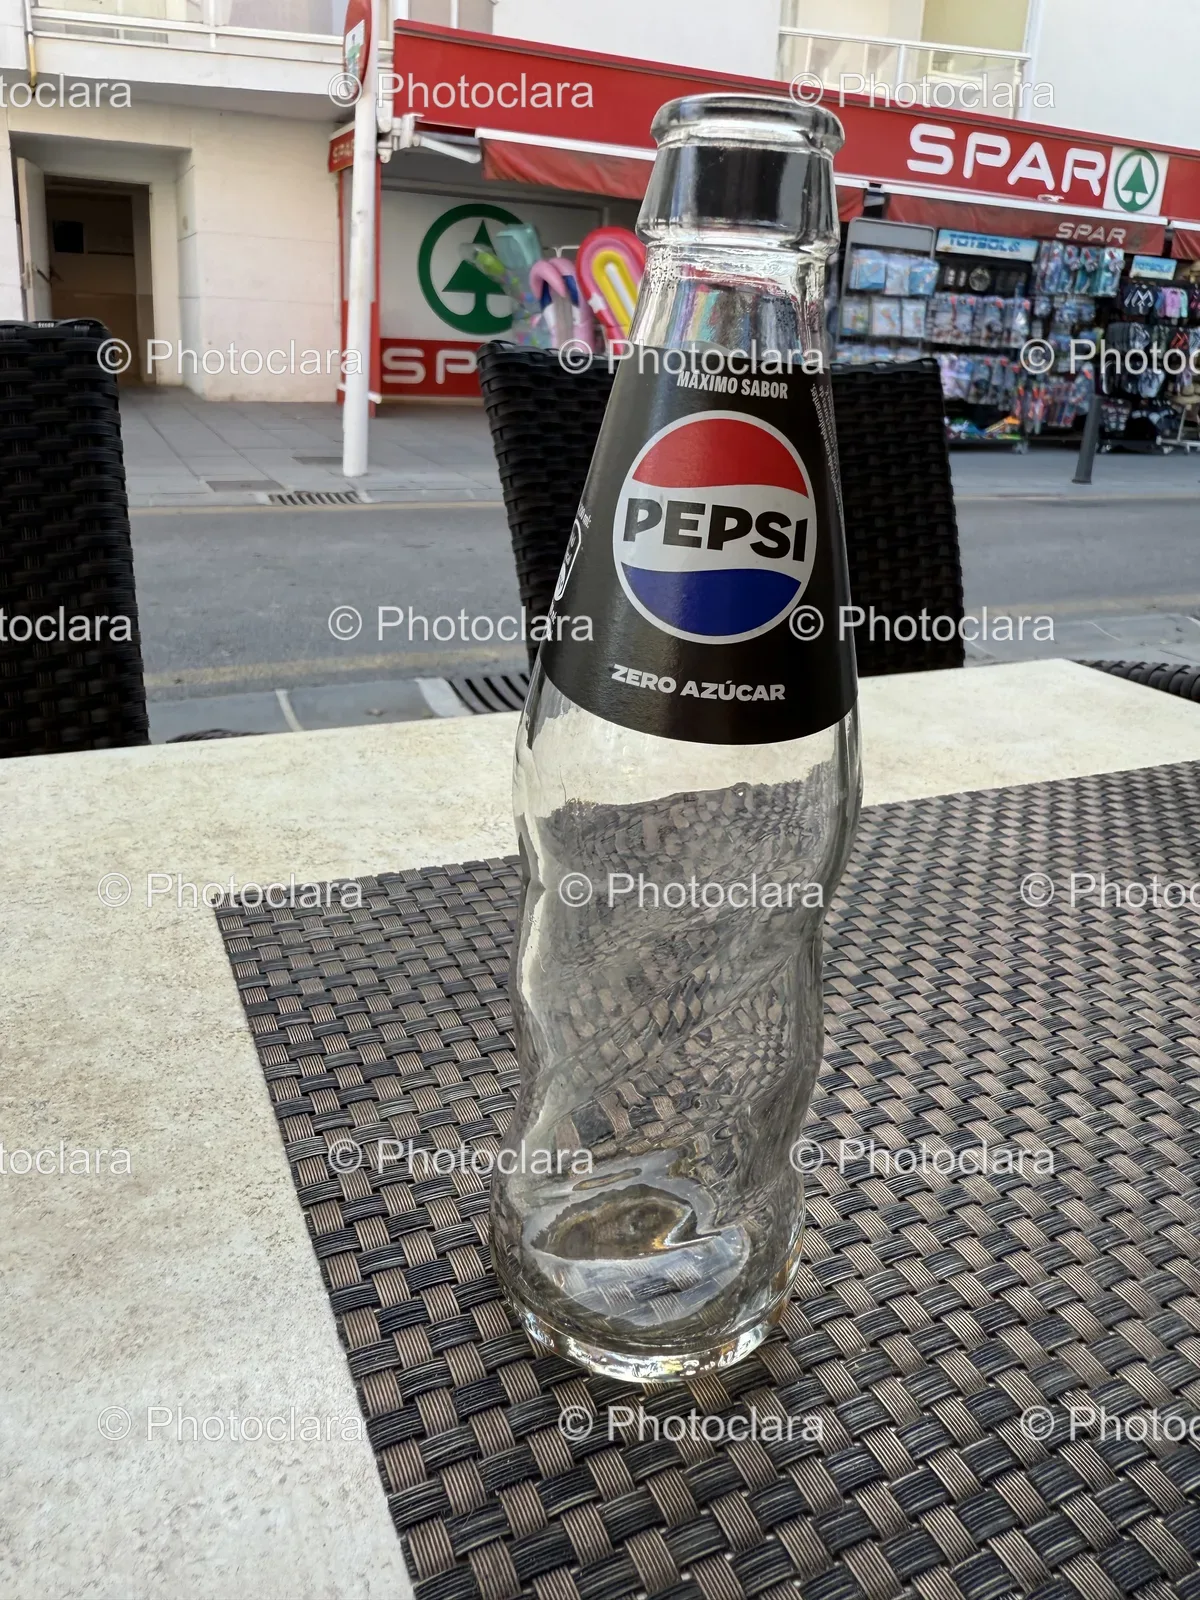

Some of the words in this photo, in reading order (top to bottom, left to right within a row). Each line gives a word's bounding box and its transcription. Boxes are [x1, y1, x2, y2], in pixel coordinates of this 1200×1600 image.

[907, 123, 1106, 196] SPAR
[1055, 222, 1127, 244] SPAR
[741, 378, 788, 399] SABOR
[623, 498, 808, 562] PEPSI
[611, 663, 677, 694] ZERO
[680, 680, 786, 701] AZÚCAR
